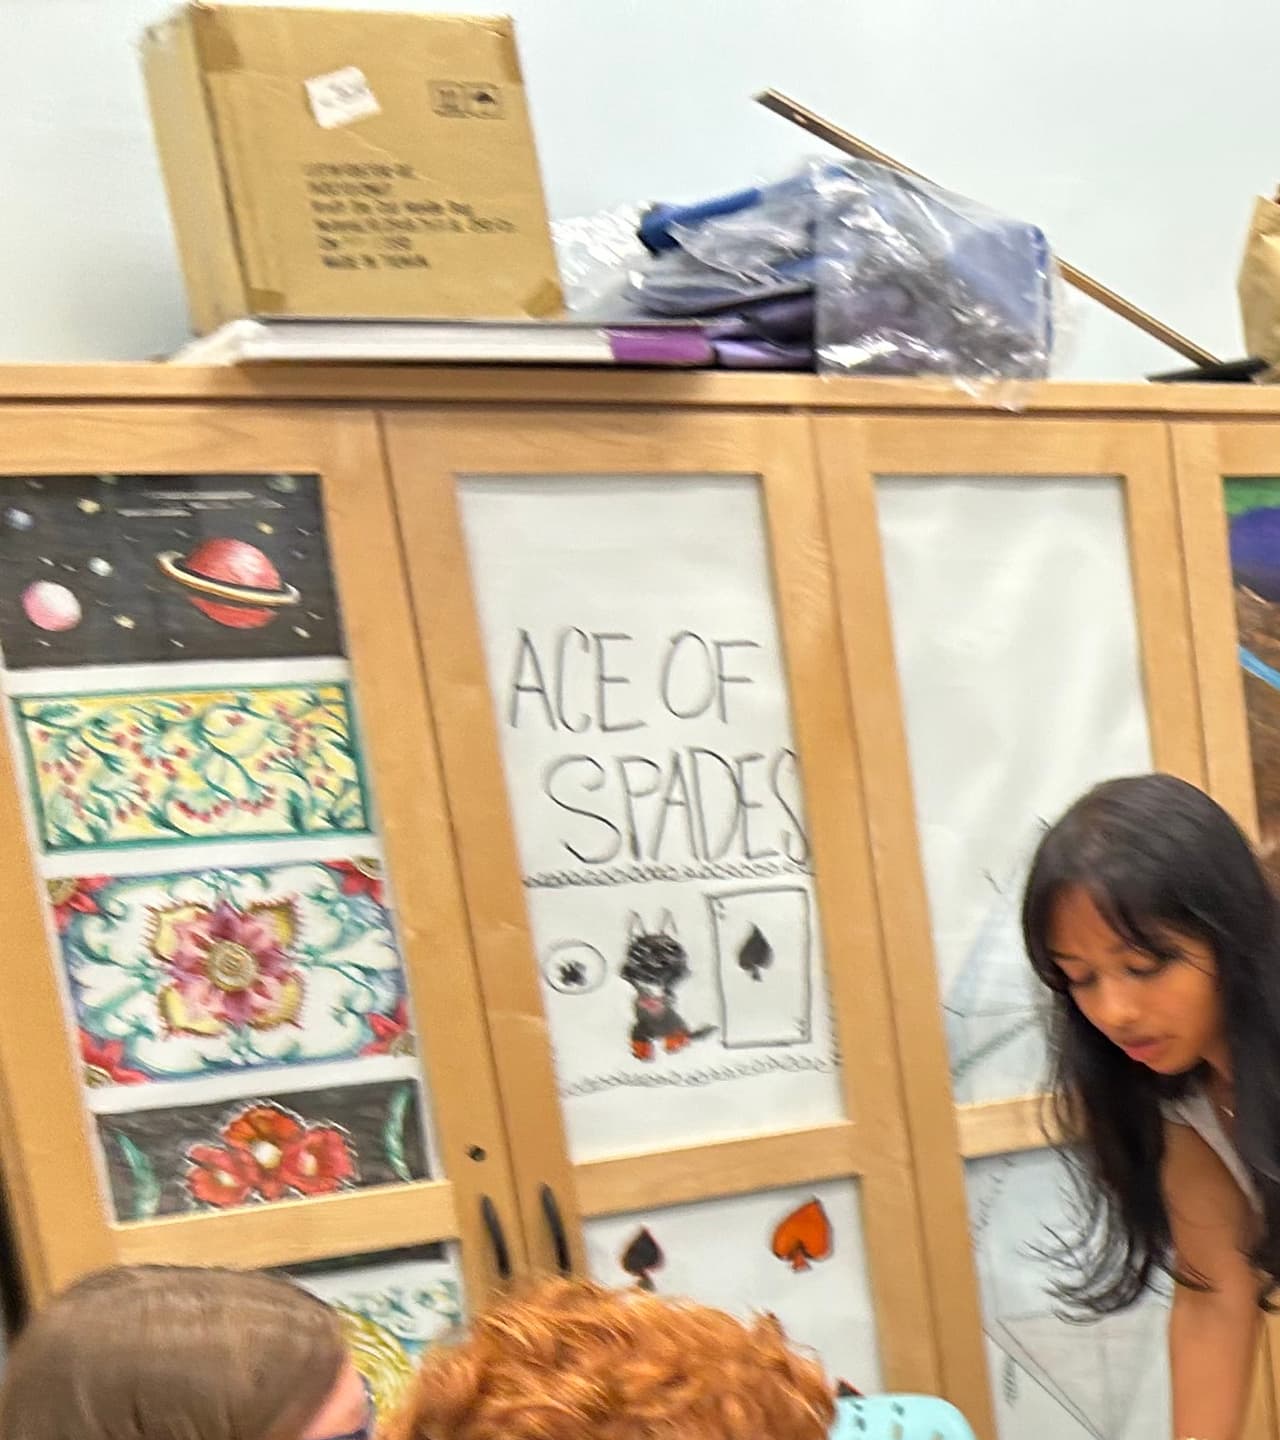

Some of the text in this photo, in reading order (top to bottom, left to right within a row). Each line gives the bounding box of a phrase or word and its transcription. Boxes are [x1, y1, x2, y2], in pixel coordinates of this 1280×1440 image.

[510, 627, 760, 732] ACE OF
[543, 748, 810, 864] SPADES
